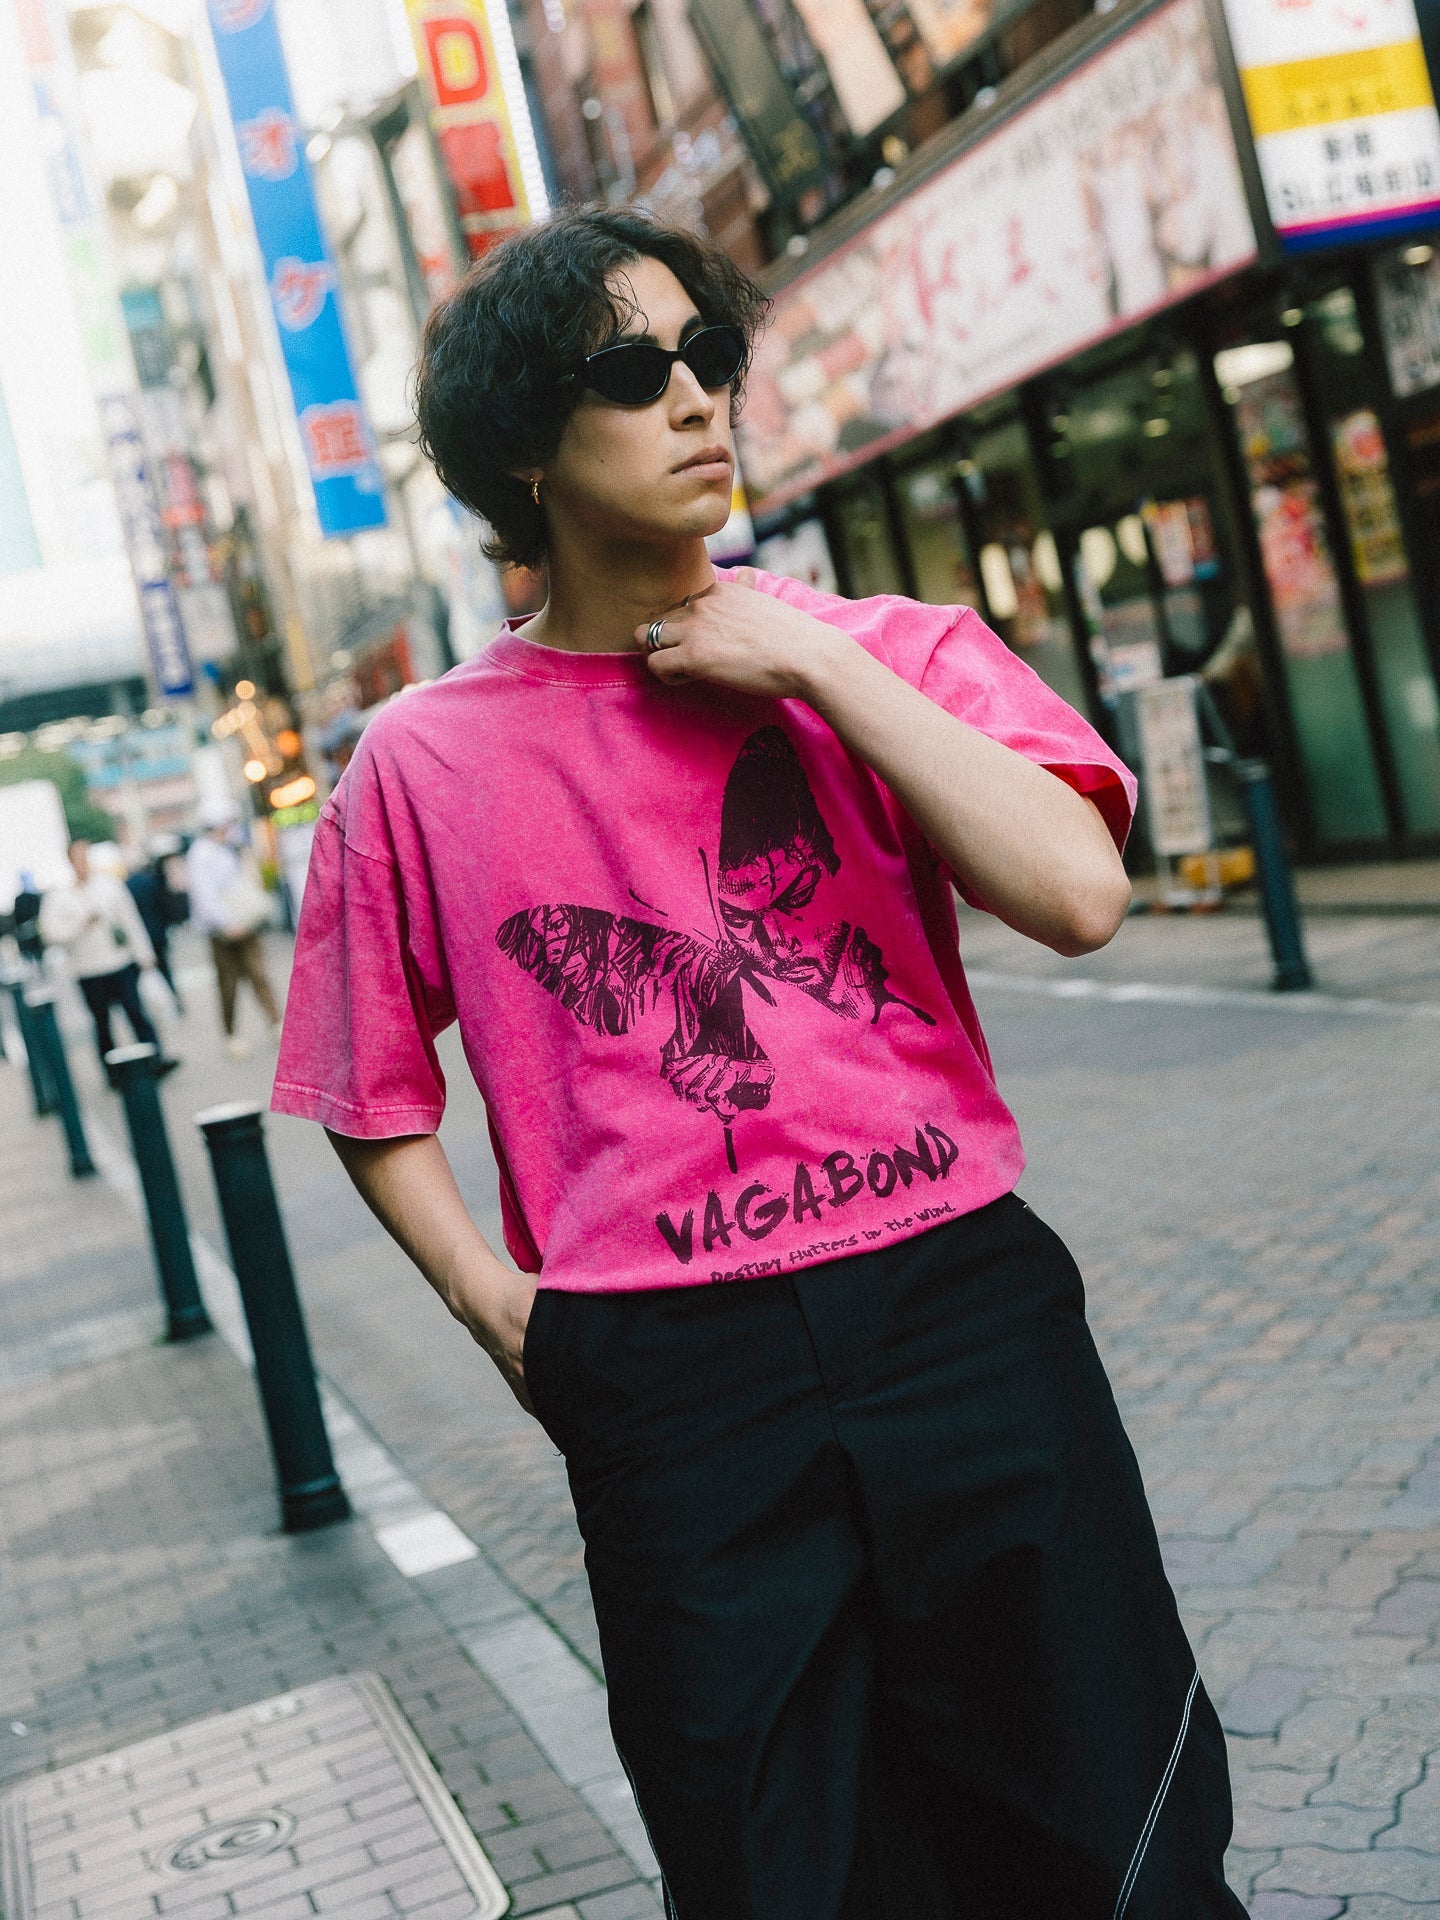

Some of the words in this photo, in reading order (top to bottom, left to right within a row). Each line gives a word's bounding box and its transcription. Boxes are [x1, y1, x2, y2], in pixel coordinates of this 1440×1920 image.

[656, 1121, 959, 1264] VAGABOND
[862, 1229, 882, 1241] in
[885, 1216, 913, 1232] the
